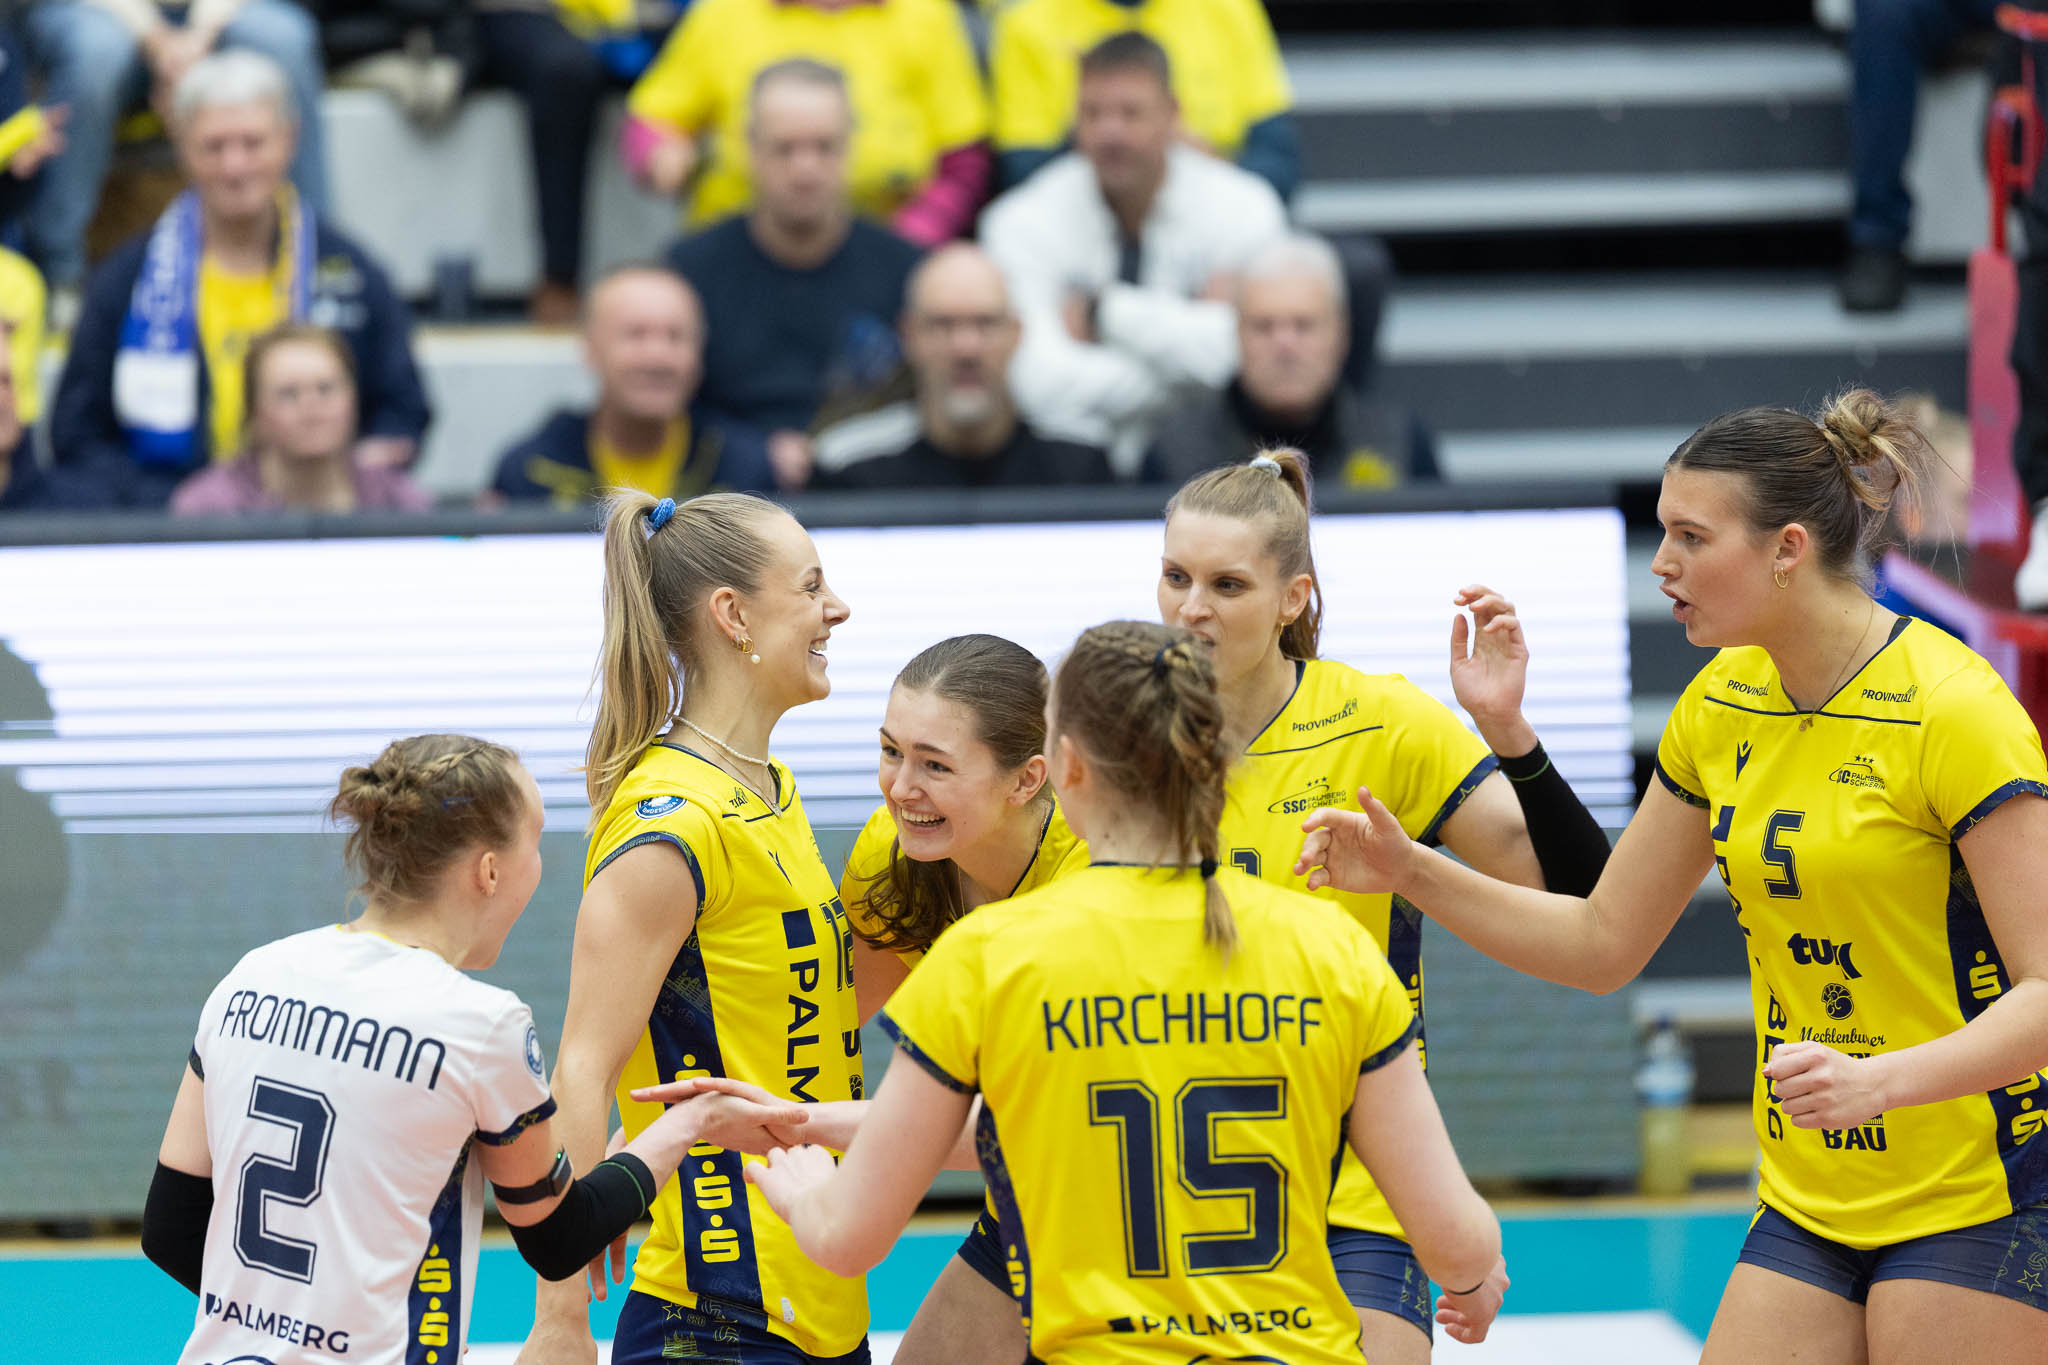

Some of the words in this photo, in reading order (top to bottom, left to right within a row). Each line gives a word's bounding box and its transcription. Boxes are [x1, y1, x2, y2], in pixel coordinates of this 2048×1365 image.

[1726, 679, 1769, 697] PROVINZIAL
[1861, 688, 1912, 703] PROVINZIAL
[1292, 707, 1355, 732] PROVINZIAL
[1283, 799, 1307, 814] SSC
[1760, 808, 1806, 900] 5
[219, 989, 446, 1091] FROMMANN
[1043, 992, 1323, 1052] KIRCHHOFF
[1821, 1126, 1888, 1152] BAU
[233, 1074, 337, 1286] 2
[1088, 1076, 1288, 1279] 15
